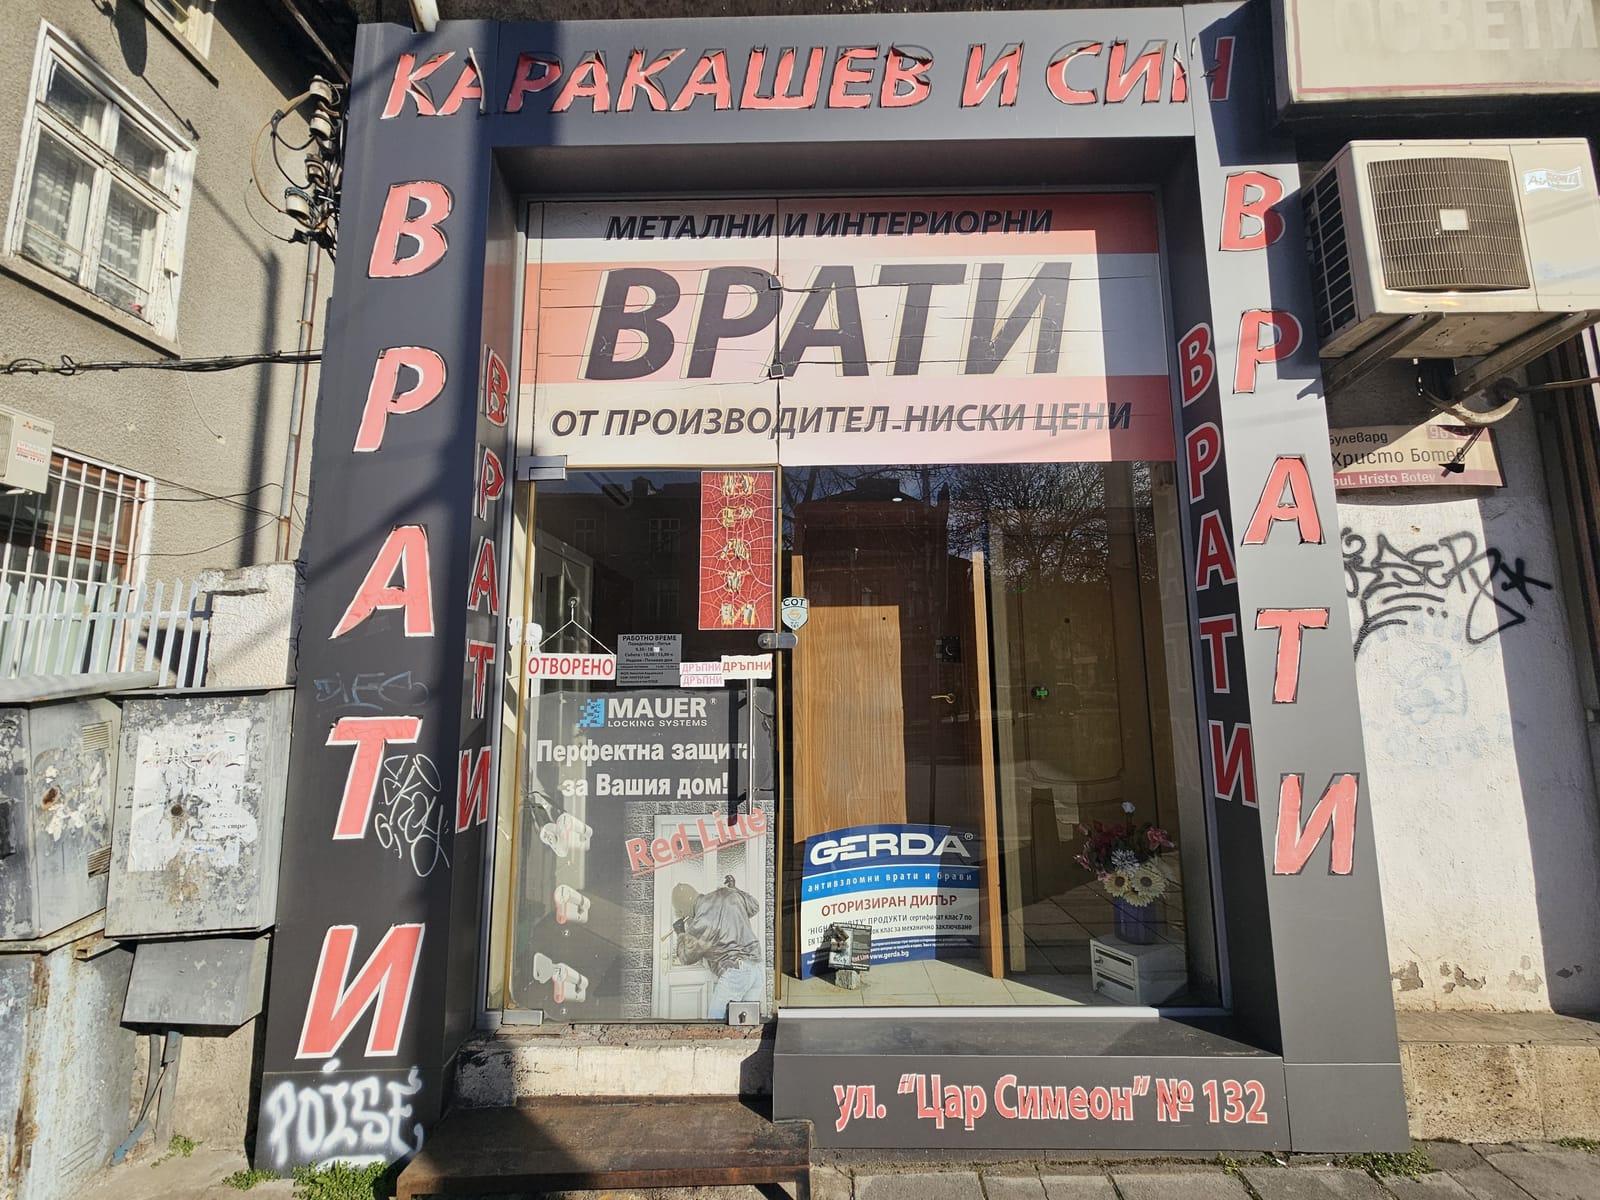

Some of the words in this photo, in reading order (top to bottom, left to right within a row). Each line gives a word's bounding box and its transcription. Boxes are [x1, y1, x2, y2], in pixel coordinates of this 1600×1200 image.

[381, 42, 934, 119] КАРАКАШЕВ
[961, 41, 1025, 109] И
[604, 213, 775, 241] МЕТАЛНИ
[782, 212, 808, 238] И
[814, 209, 1054, 238] ИНТЕРИОРНИ
[577, 262, 1073, 381] ВРАТИ
[551, 410, 598, 437] ОТ
[1032, 402, 1132, 437] ЦЕНИ
[1332, 450, 1405, 468] Христо
[1359, 473, 1398, 484] Hristo
[1401, 471, 1436, 483] Botev
[528, 657, 614, 676] ОТВОРЕНО
[682, 663, 720, 673] ДРЪПНИ
[722, 661, 771, 672] ДРЪПНИ
[682, 675, 723, 686] ДРЪПНИ
[607, 720, 655, 728] LOCKING
[659, 719, 708, 728] SYSTEMS
[536, 739, 664, 767] Перфектна
[671, 743, 756, 763] защита
[561, 779, 588, 796] за
[596, 773, 671, 796] Вашия
[677, 772, 729, 799] дом!
[625, 823, 692, 871] Red
[696, 807, 766, 849] Line
[807, 874, 881, 893] антивзломни
[886, 872, 919, 883] врати
[936, 872, 972, 881] брави
[821, 896, 907, 917] ОТОРИЗИРАН
[909, 894, 957, 909] ДИЛЪР
[868, 914, 908, 925] ПРОДУКТИ
[833, 1083, 887, 1132] ул.
[1156, 1078, 1194, 1122] №
[1202, 1079, 1268, 1124] 132
